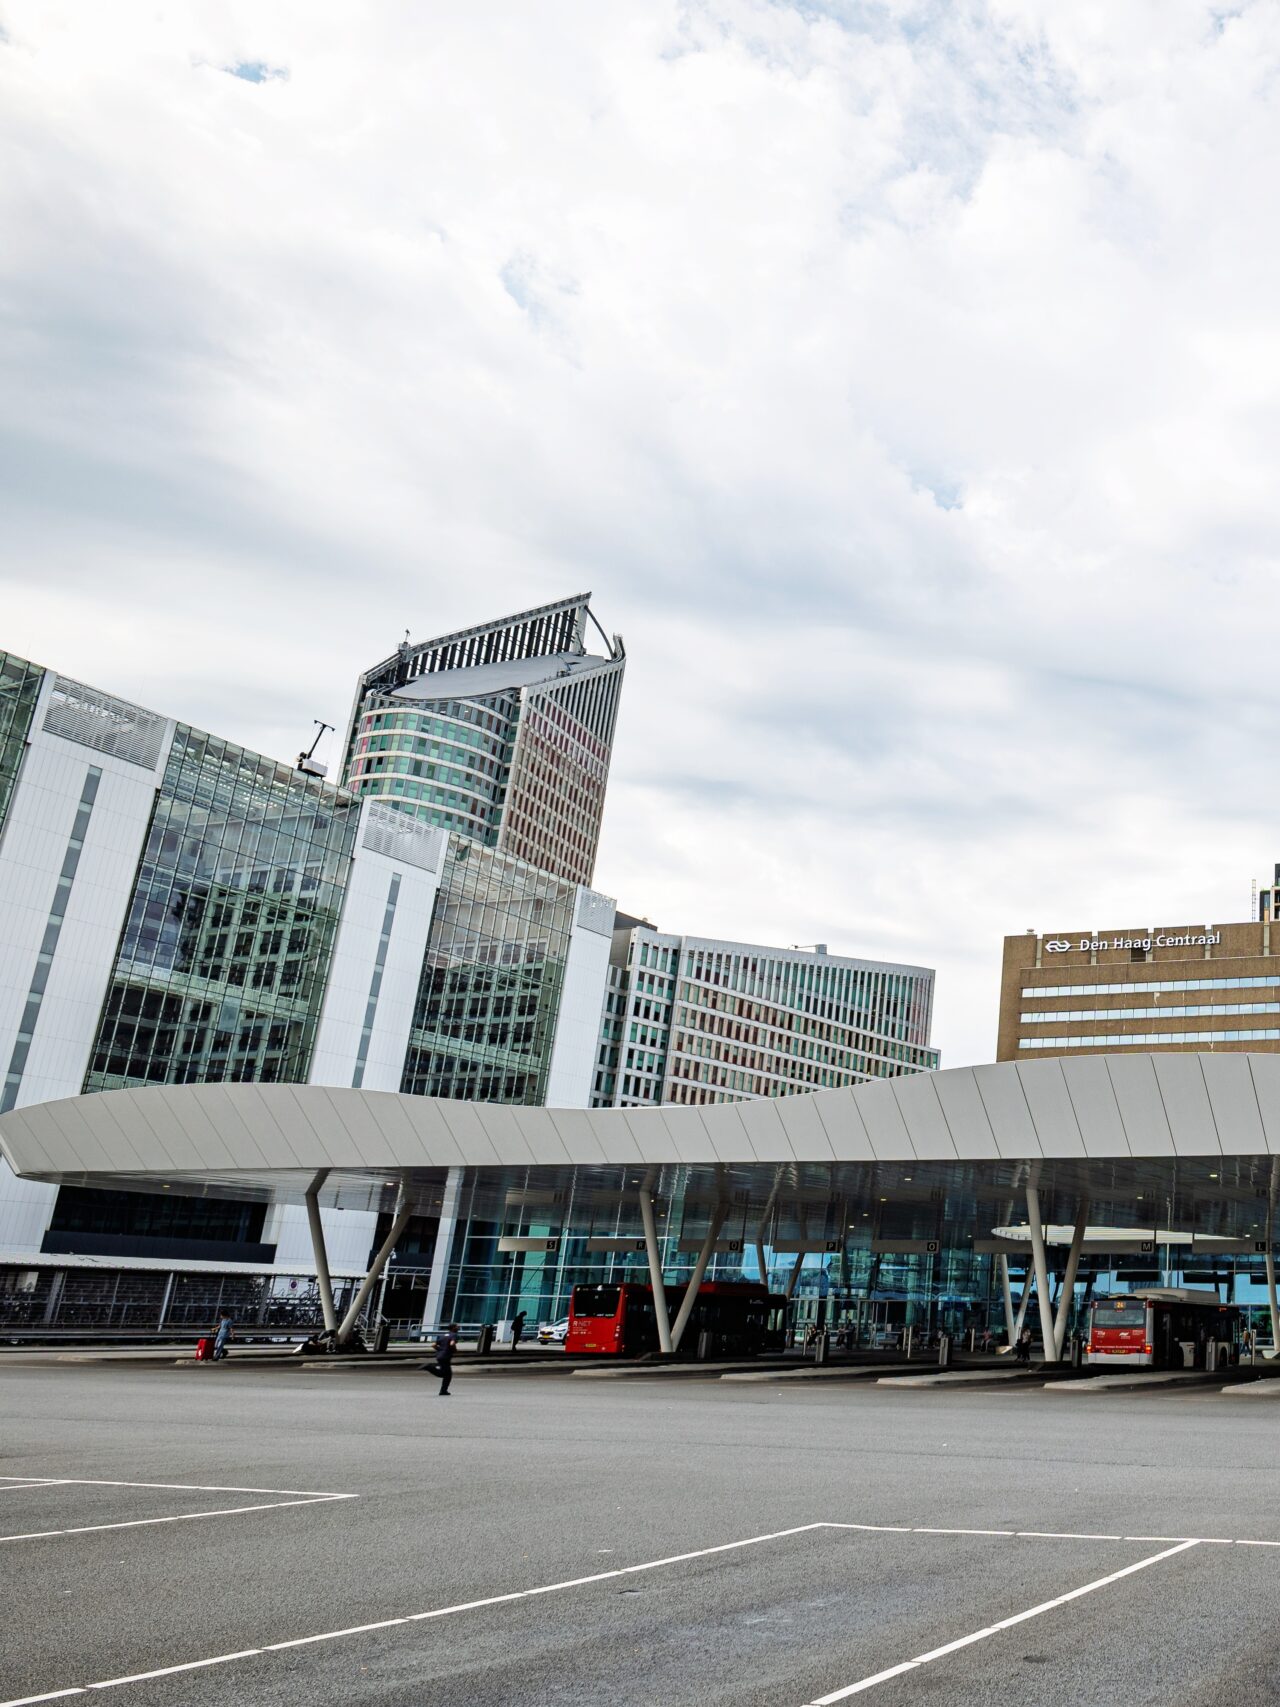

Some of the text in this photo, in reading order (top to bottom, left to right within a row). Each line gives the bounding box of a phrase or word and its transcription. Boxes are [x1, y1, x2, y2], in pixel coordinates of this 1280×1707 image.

[1080, 931, 1221, 952] Den Haag Centraal
